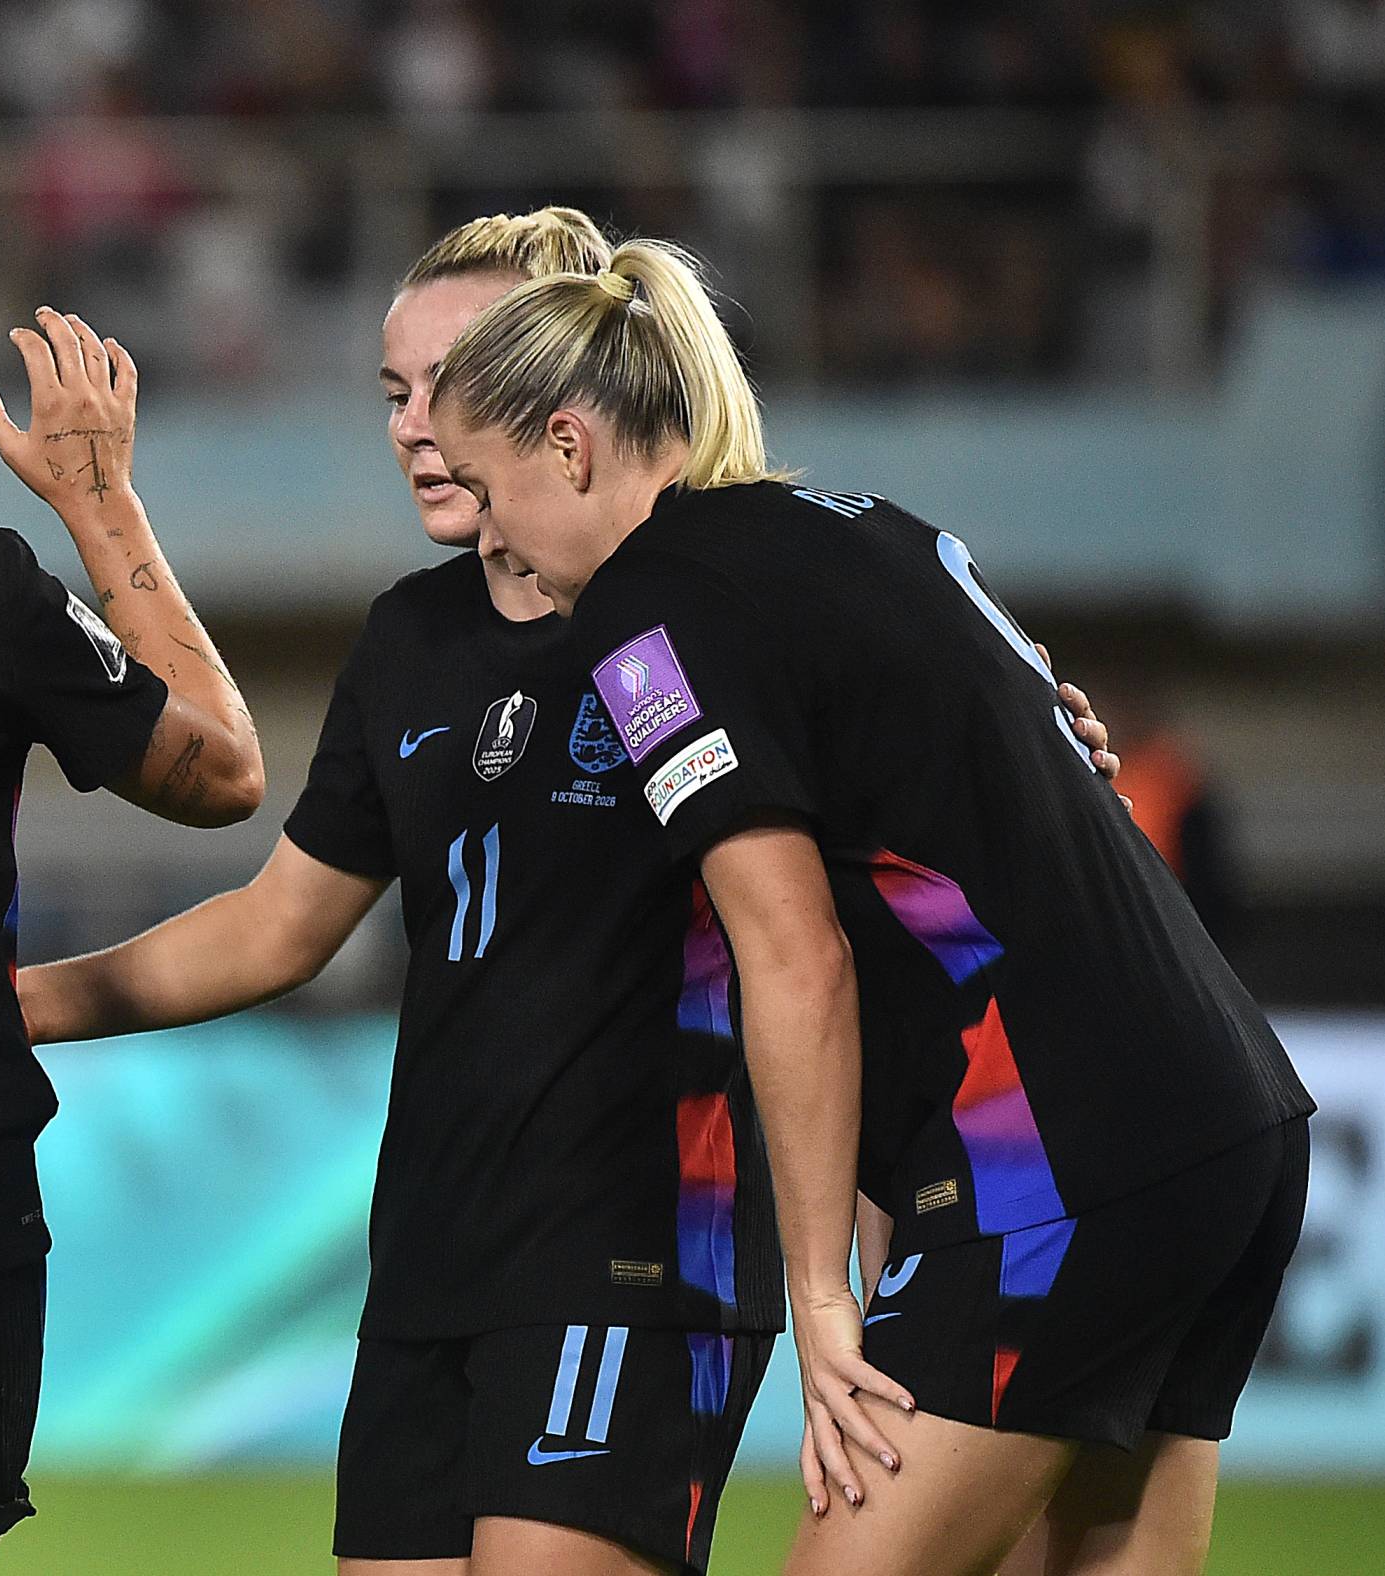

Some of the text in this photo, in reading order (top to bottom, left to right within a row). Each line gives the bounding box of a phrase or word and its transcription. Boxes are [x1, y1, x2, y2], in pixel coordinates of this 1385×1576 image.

[625, 688, 682, 737] EUROPEAN
[629, 699, 688, 748] QUALIFIERS
[481, 750, 513, 759] EUROPEAN
[558, 791, 594, 806] OCTOBER
[572, 779, 601, 794] GREECE
[447, 821, 500, 962] 11
[545, 1324, 630, 1444] 11
